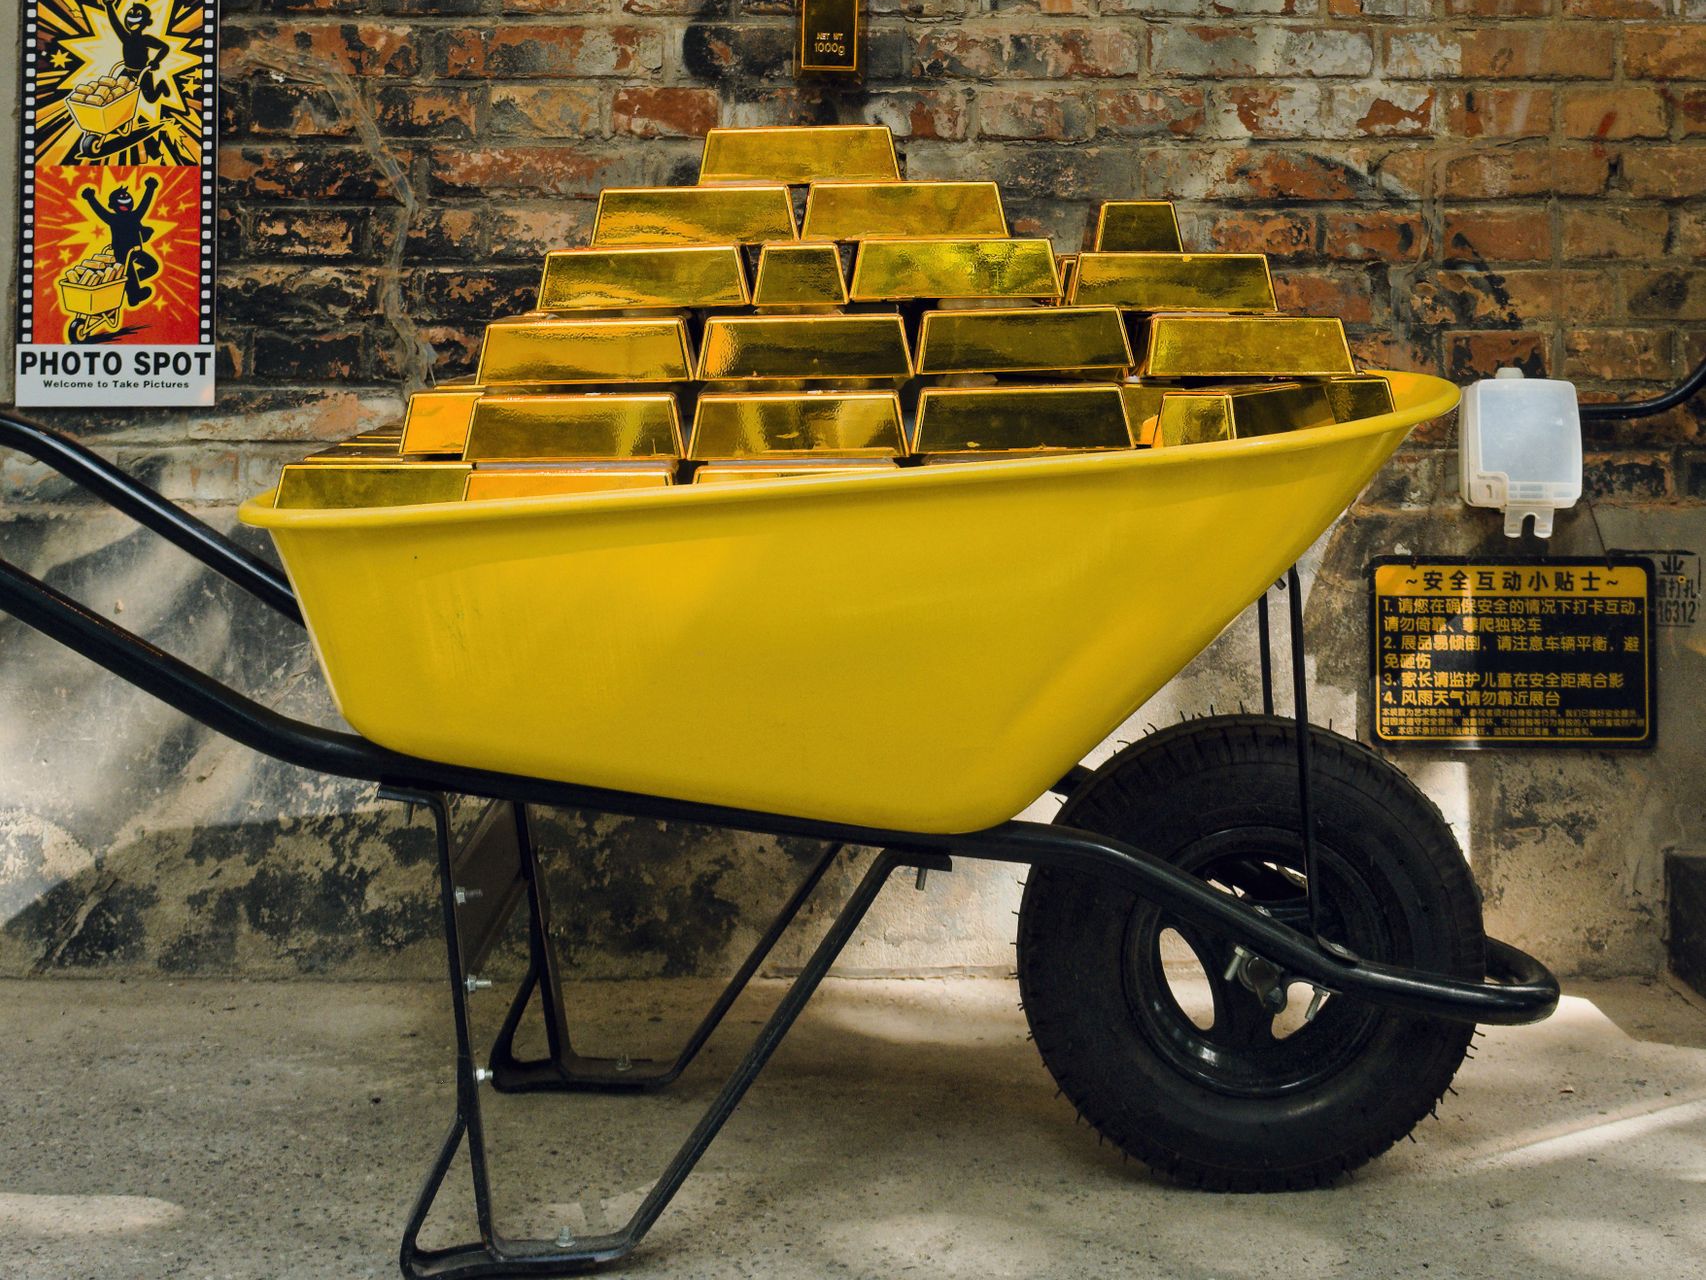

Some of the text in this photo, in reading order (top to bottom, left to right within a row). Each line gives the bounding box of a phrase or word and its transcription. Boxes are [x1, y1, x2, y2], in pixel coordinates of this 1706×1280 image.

[814, 42, 845, 55] 1000g
[20, 351, 212, 376] PHOTO SPOT
[43, 380, 189, 388] Welcome to Take Pictures
[1384, 653, 1431, 669] 免砸伤
